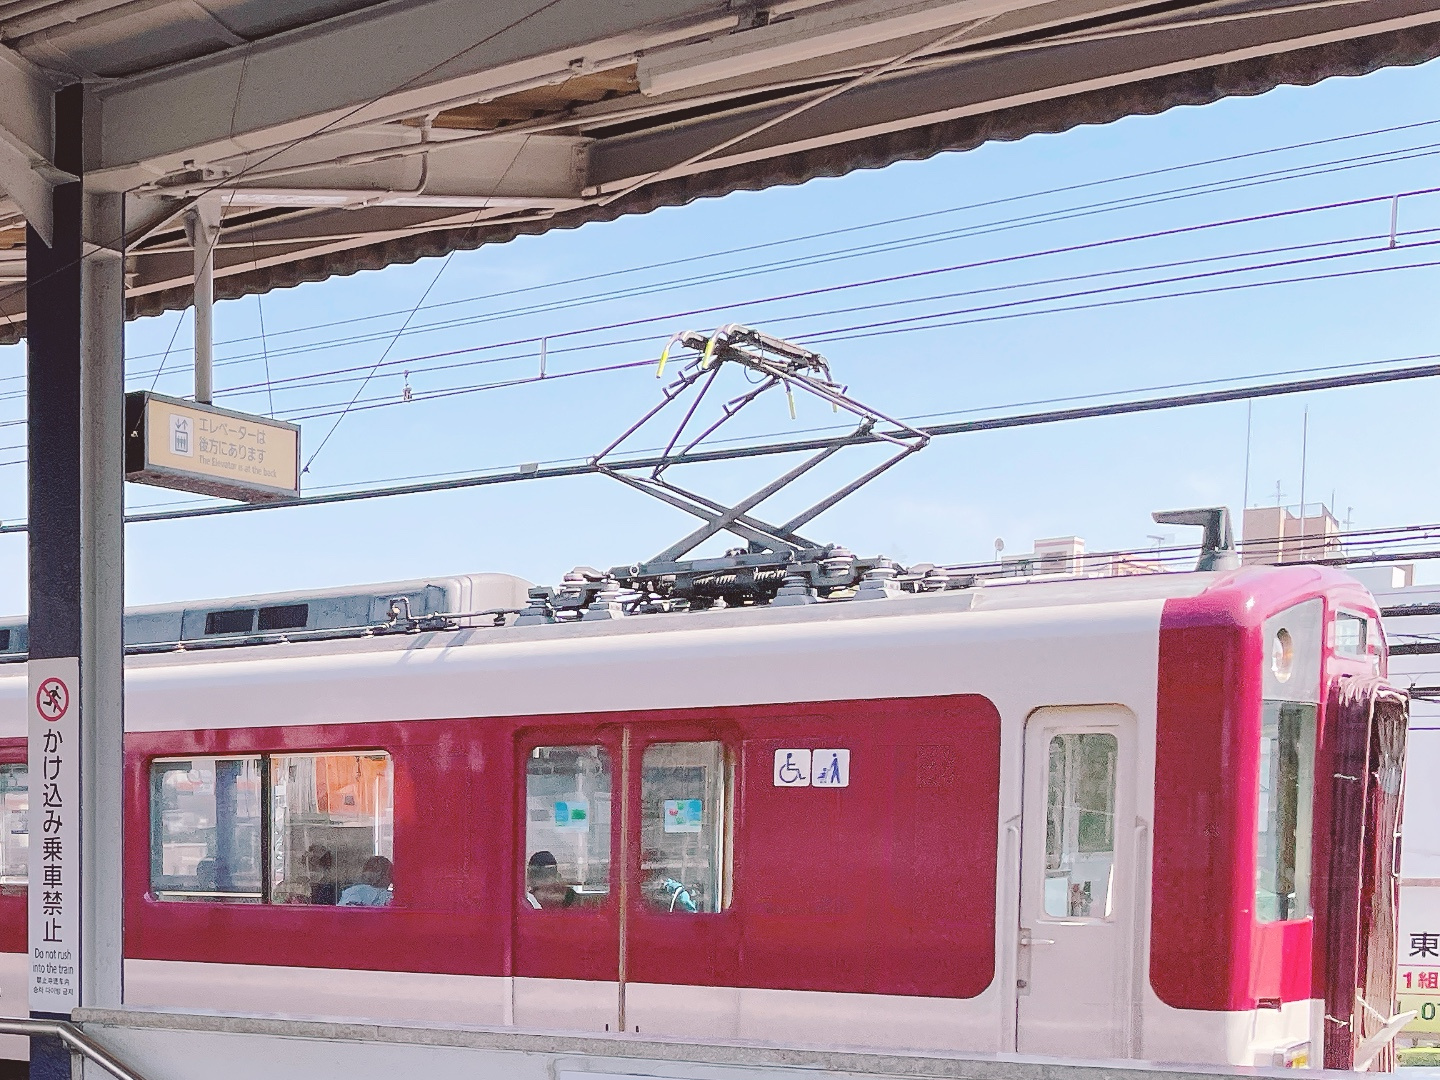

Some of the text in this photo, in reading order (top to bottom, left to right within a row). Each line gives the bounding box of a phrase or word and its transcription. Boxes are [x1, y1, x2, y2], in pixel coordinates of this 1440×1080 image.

[199, 418, 266, 444] エレベーターは
[199, 436, 267, 464] 後方にあります
[42, 728, 64, 943] かけ込み乗車禁止
[34, 947, 72, 960] Do not rush
[32, 962, 74, 975] into the train
[1421, 1002, 1440, 1021] 0
